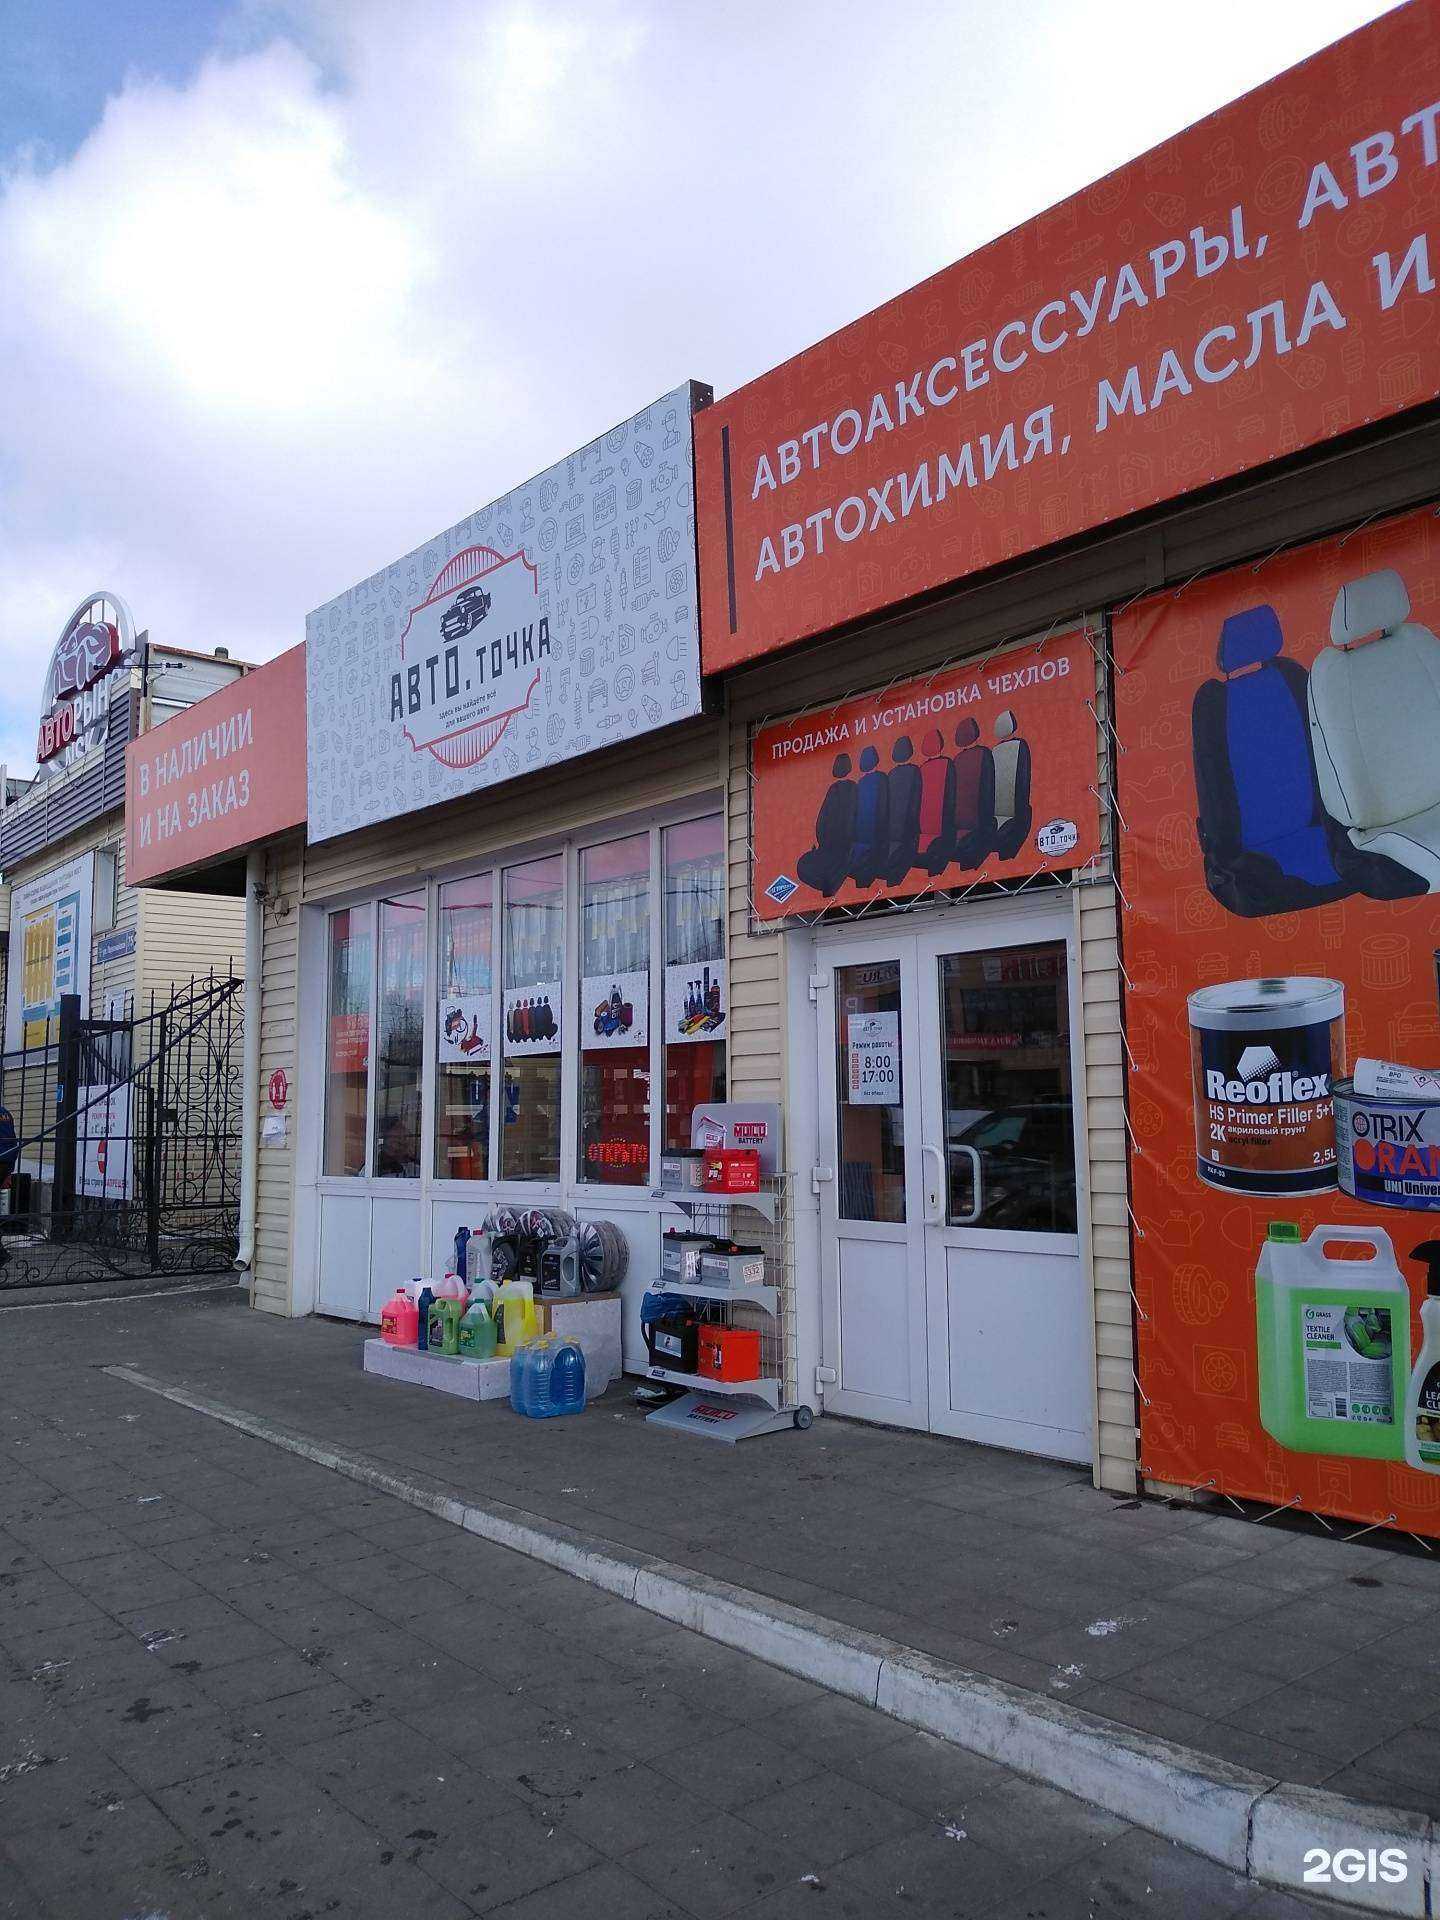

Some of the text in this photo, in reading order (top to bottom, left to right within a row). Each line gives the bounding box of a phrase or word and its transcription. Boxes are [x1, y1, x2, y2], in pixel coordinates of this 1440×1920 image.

[751, 205, 1268, 500] АВТОАКСЕССУАРЫ,
[755, 232, 1436, 582] АВТОХИМИЯ, МАСЛА И
[771, 656, 1071, 760] ПРОДАЖА И УСТАНОВКА ЧЕХЛОВ
[139, 707, 254, 797] В НАЛИЧИИ
[139, 768, 251, 849] И НА ЗАКАЗ
[862, 1069, 894, 1083] 17:00
[864, 1055, 891, 1069] 8:00
[1206, 1069, 1329, 1104] Reoflex
[1209, 1104, 1225, 1121] HS
[1227, 1107, 1273, 1125] Primer
[1278, 1107, 1313, 1124] Filler
[1210, 1123, 1227, 1142] 2K
[1227, 1125, 1306, 1136] акриловый грунт
[1306, 1332, 1335, 1340] CLEANER
